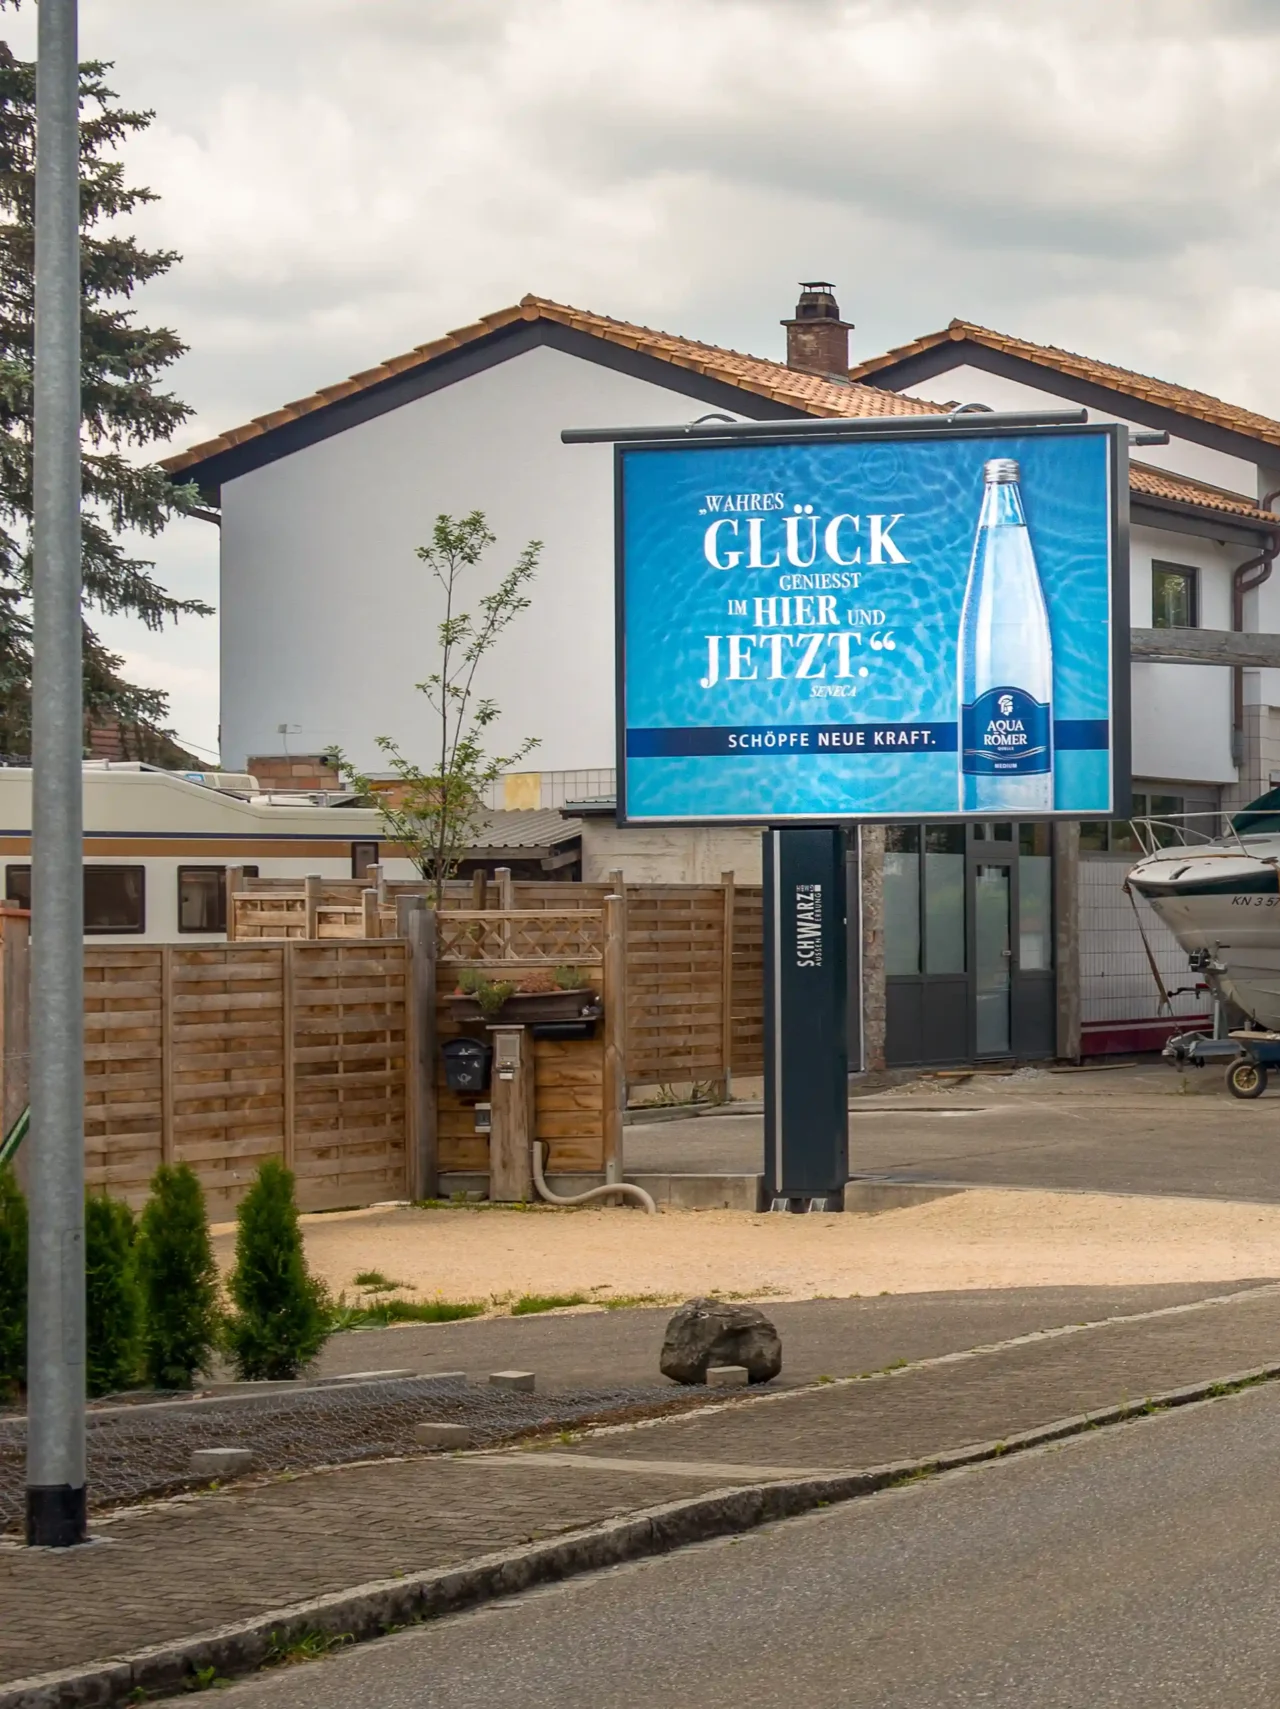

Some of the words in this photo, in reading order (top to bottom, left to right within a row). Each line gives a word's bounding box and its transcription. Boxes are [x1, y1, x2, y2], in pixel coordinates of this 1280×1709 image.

[704, 504, 911, 570] GLÜCK
[779, 572, 861, 590] GENIESST
[728, 600, 747, 615] IM
[753, 595, 840, 627] HIER
[847, 609, 885, 626] UND
[809, 684, 858, 698] SENECA
[987, 720, 1025, 735] AQUA
[728, 731, 810, 748] SCHÖPFE
[818, 732, 866, 746] NEUE
[874, 730, 937, 745] KRAFT.
[984, 732, 1028, 746] RÖMER
[1231, 896, 1252, 906] KN
[796, 893, 822, 967] SCHWARZ
